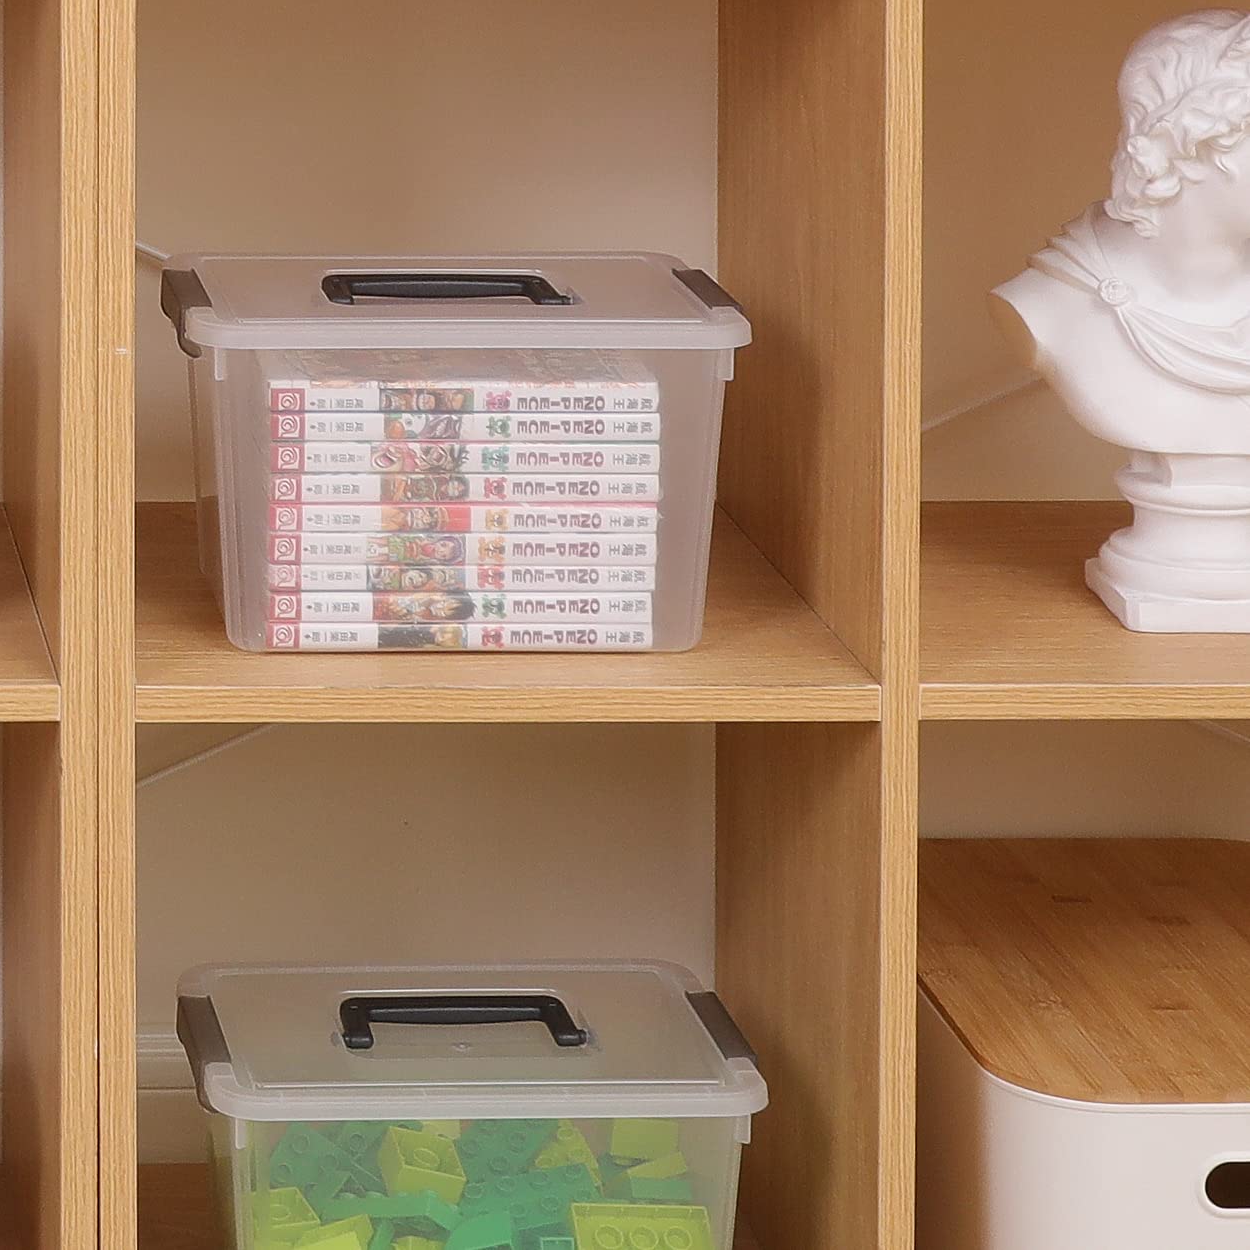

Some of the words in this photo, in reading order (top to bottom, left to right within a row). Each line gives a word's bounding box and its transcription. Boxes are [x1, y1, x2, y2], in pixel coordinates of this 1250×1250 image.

[517, 397, 571, 410] PIECE
[574, 396, 605, 410] ONE
[517, 420, 571, 434] PIECE
[573, 419, 605, 435] ONE
[516, 452, 570, 466] PIECE
[572, 451, 604, 467] ONE
[512, 481, 566, 495] PIECE
[568, 480, 600, 496] ONE
[514, 514, 567, 527] PIECE
[570, 513, 601, 529] ONE
[512, 542, 566, 556] PIECE
[568, 542, 600, 558] ONE
[512, 569, 565, 583] PIECE
[568, 569, 599, 584] ONE
[513, 600, 566, 614] PIECE
[569, 599, 600, 614] ONE
[510, 630, 564, 644] PIECE
[566, 629, 597, 644] ONE
